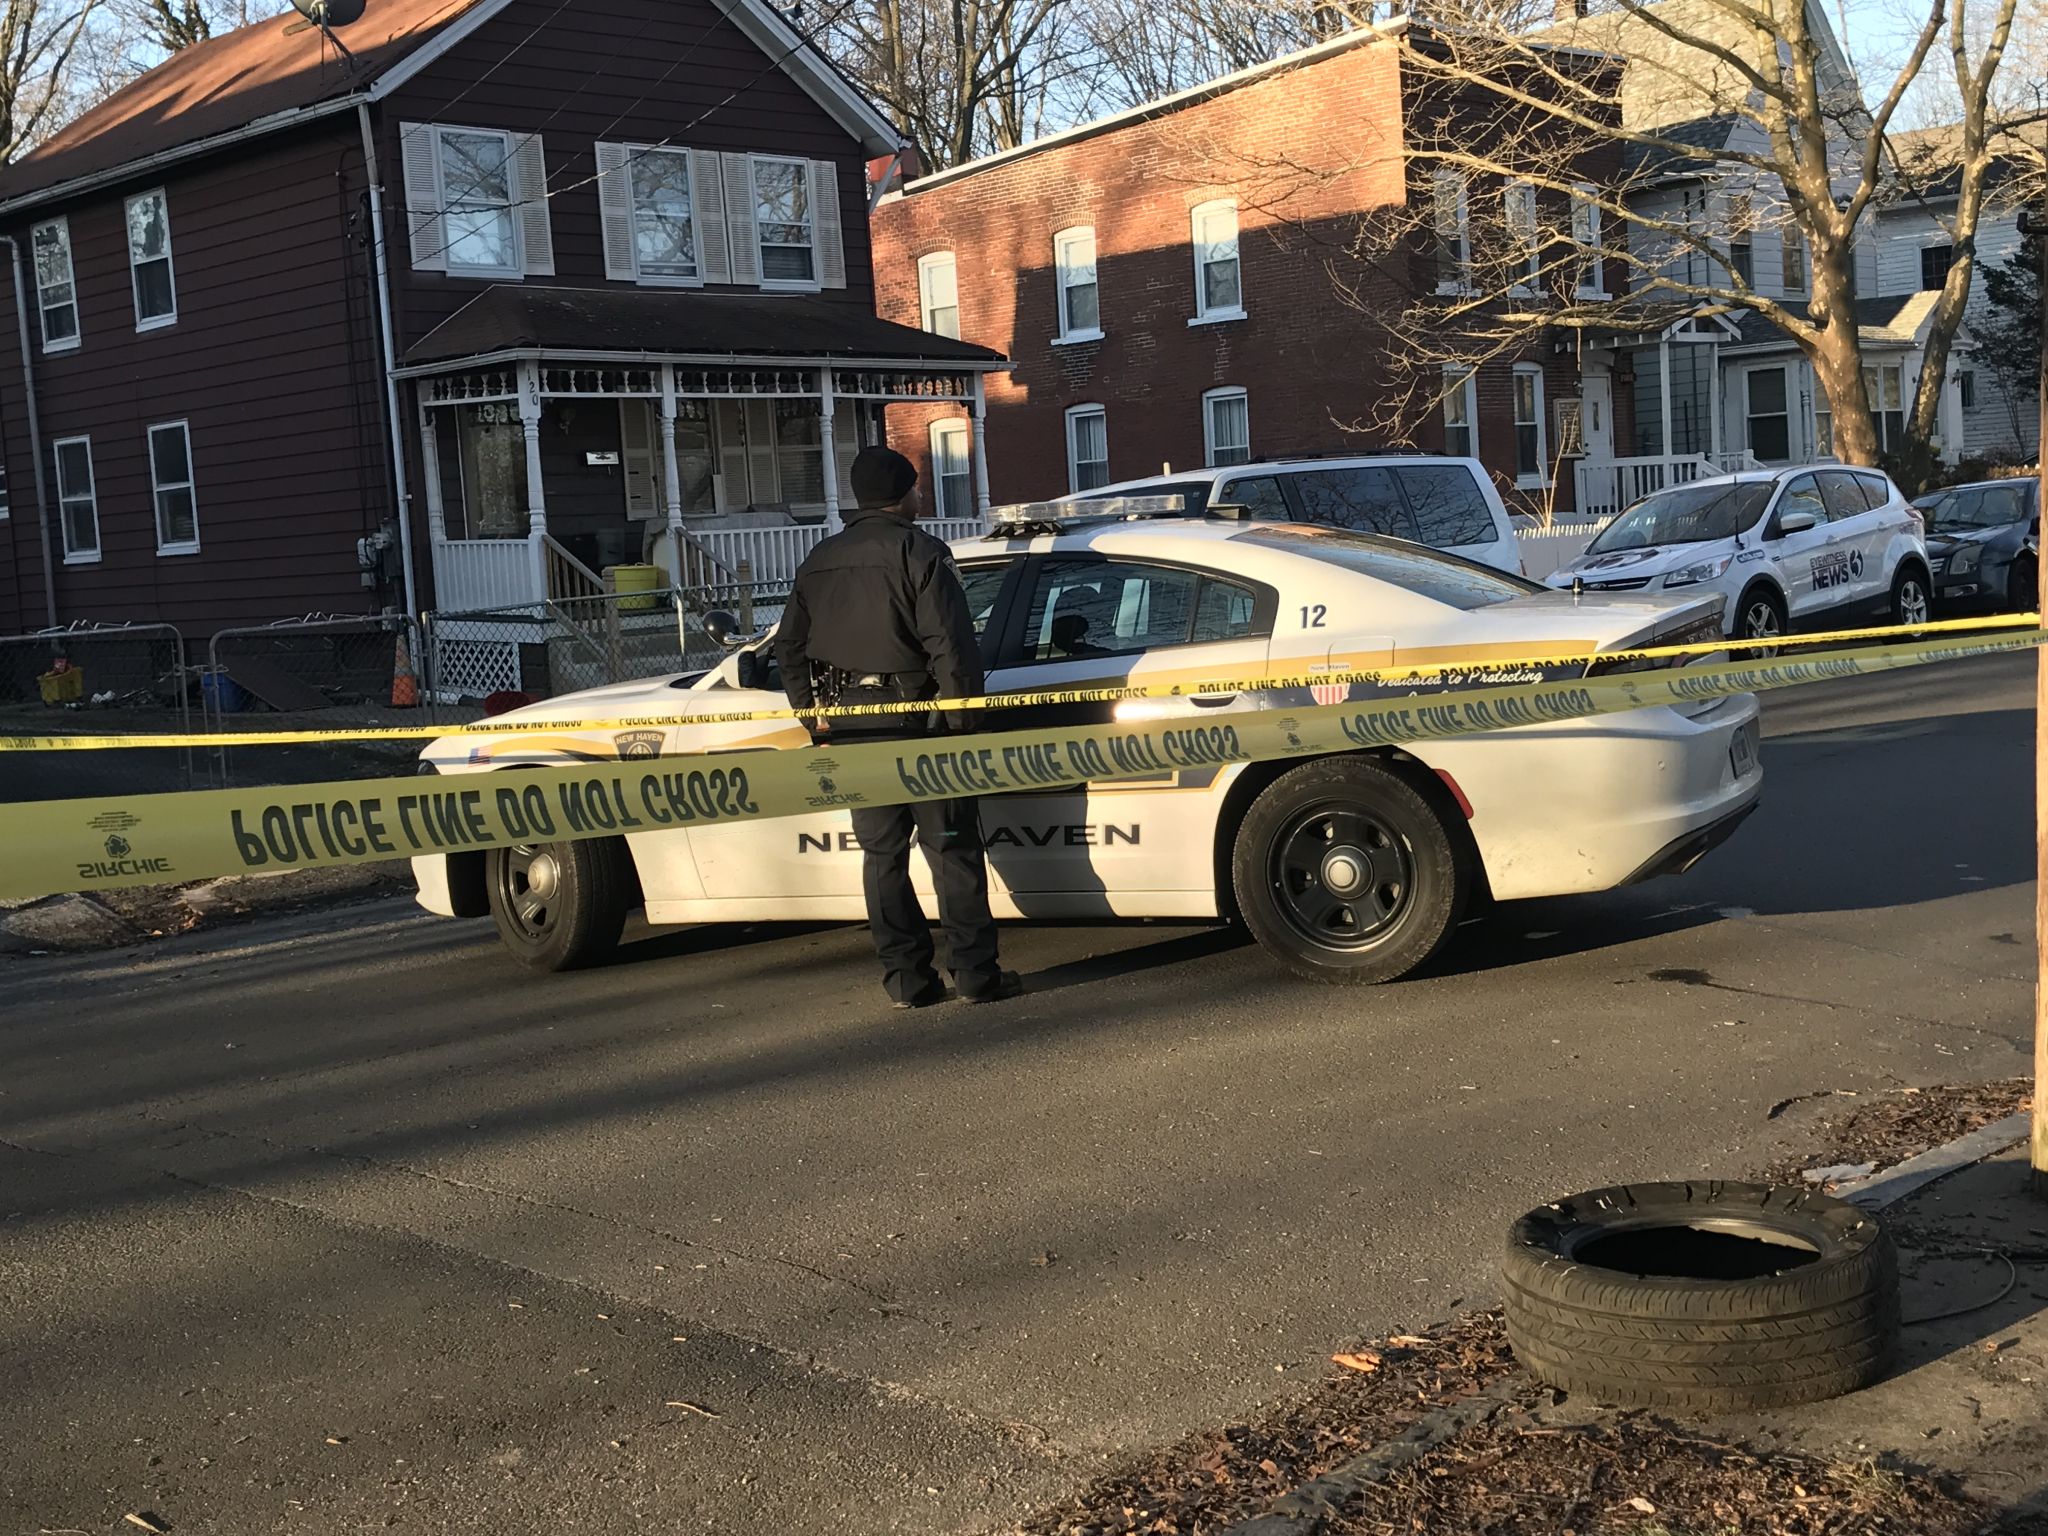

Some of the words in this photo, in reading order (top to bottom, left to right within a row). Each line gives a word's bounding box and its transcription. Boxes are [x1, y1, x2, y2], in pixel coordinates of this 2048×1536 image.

[527, 368, 539, 406] 120
[1809, 549, 1847, 568] EYEWITNESS
[1811, 562, 1850, 591] NEWS
[1300, 604, 1327, 629] 12
[1448, 674, 1464, 685] to
[1468, 670, 1543, 685] Protecting
[616, 735, 634, 744] NEW
[636, 731, 663, 742] HAVEN
[799, 831, 863, 853] NE
[986, 823, 1142, 847] AVEN
